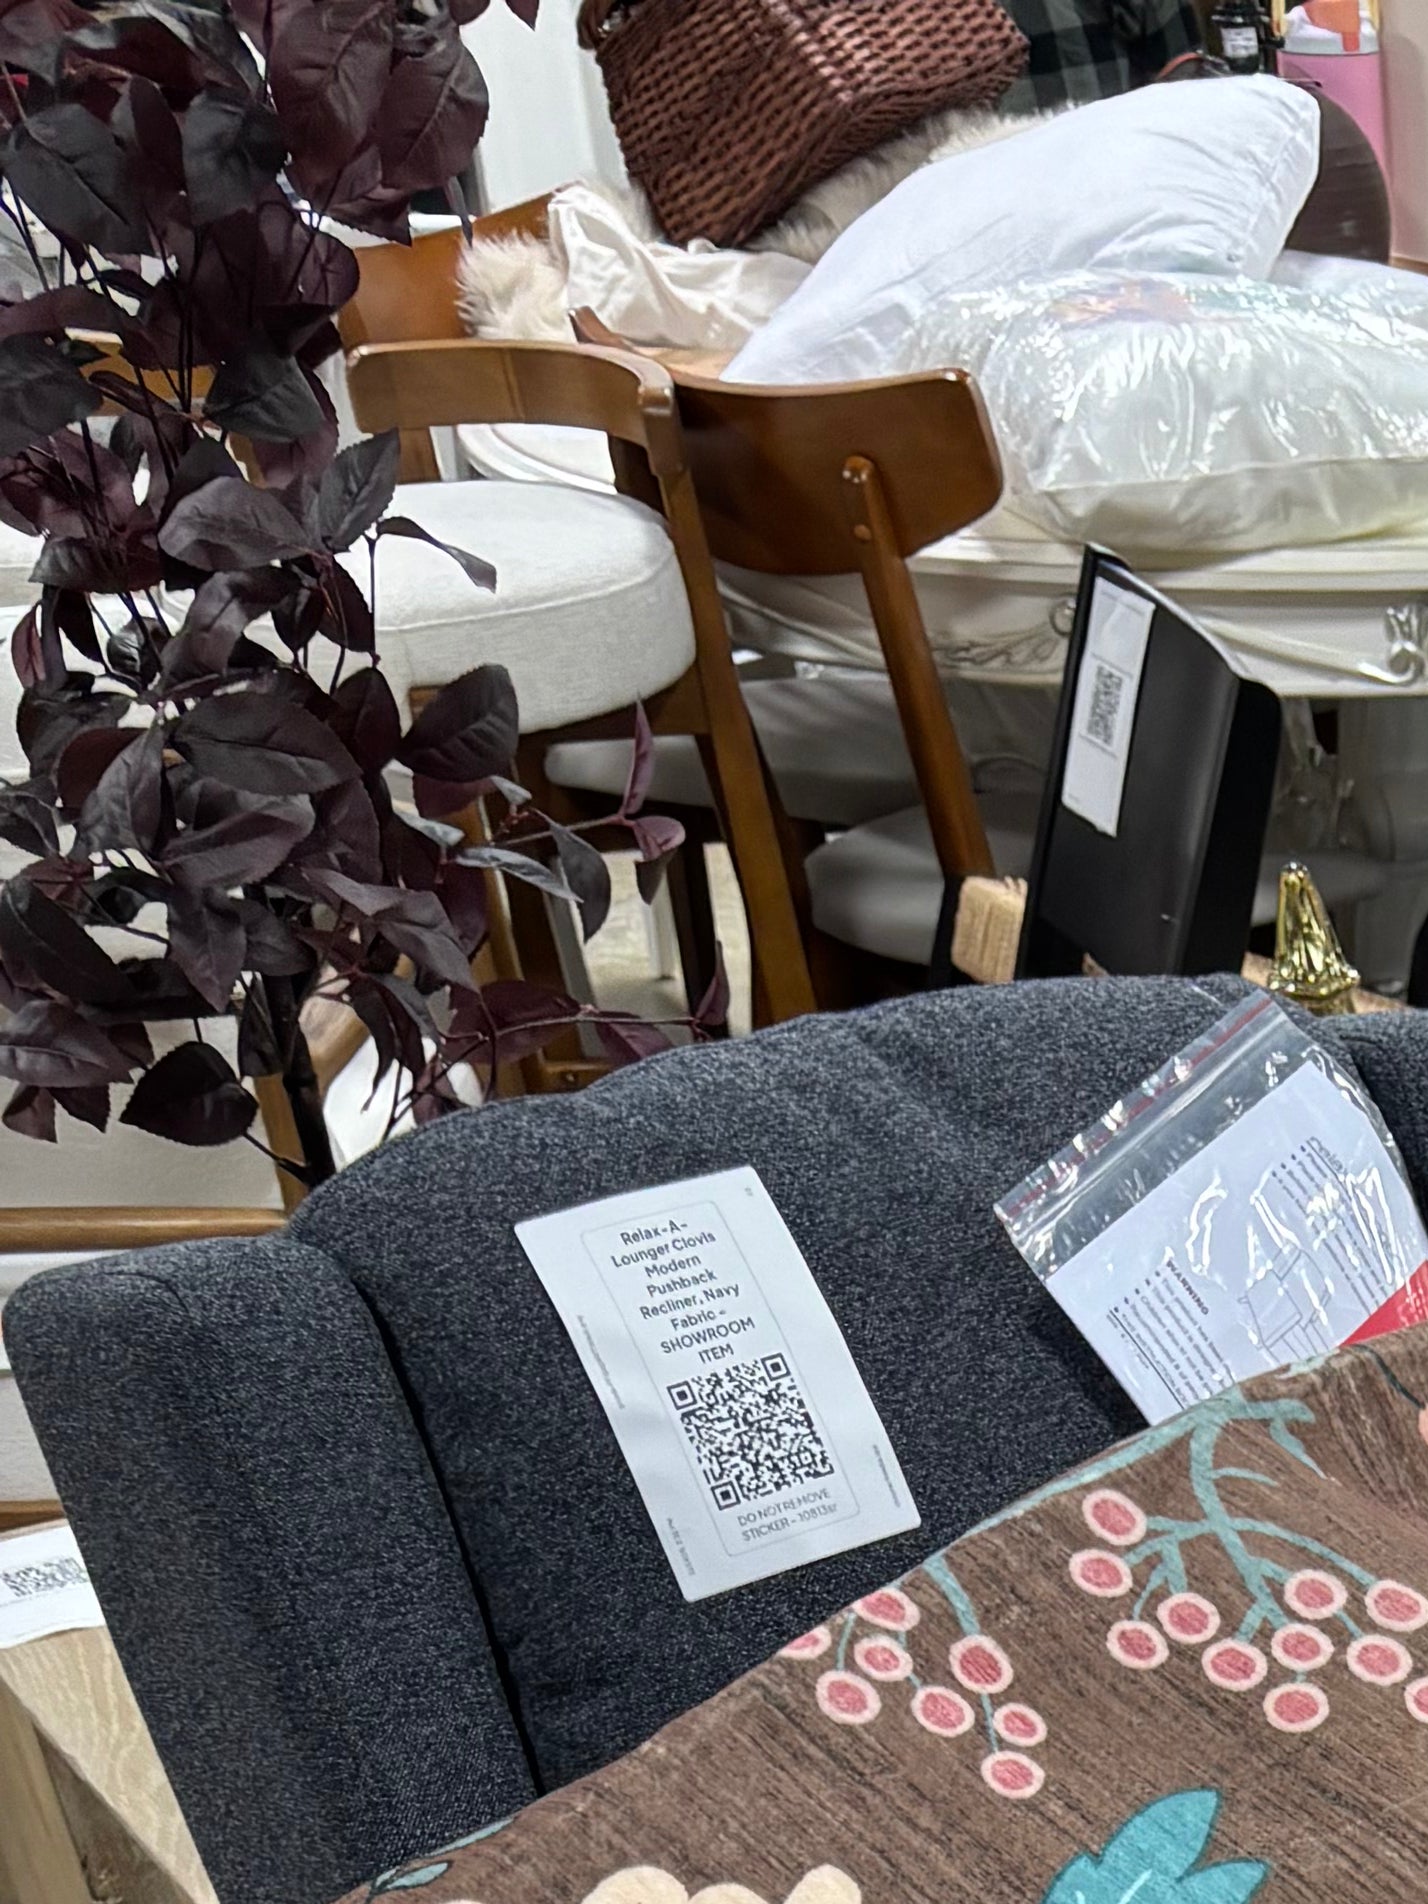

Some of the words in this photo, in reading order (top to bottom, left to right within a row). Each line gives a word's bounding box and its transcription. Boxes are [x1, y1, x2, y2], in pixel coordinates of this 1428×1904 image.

[611, 1243, 670, 1268] Lounger
[672, 1232, 716, 1252] Clovis
[644, 1255, 701, 1278] Modern
[646, 1269, 718, 1297] Pushback
[639, 1294, 704, 1319] Recliner,
[702, 1284, 740, 1302] Navy
[670, 1310, 717, 1331] Fabric
[661, 1317, 755, 1354] SHOWROOM
[698, 1343, 734, 1364] ITEM
[737, 1512, 757, 1527] DO
[758, 1503, 782, 1519] NOT
[742, 1518, 790, 1542] STICKER
